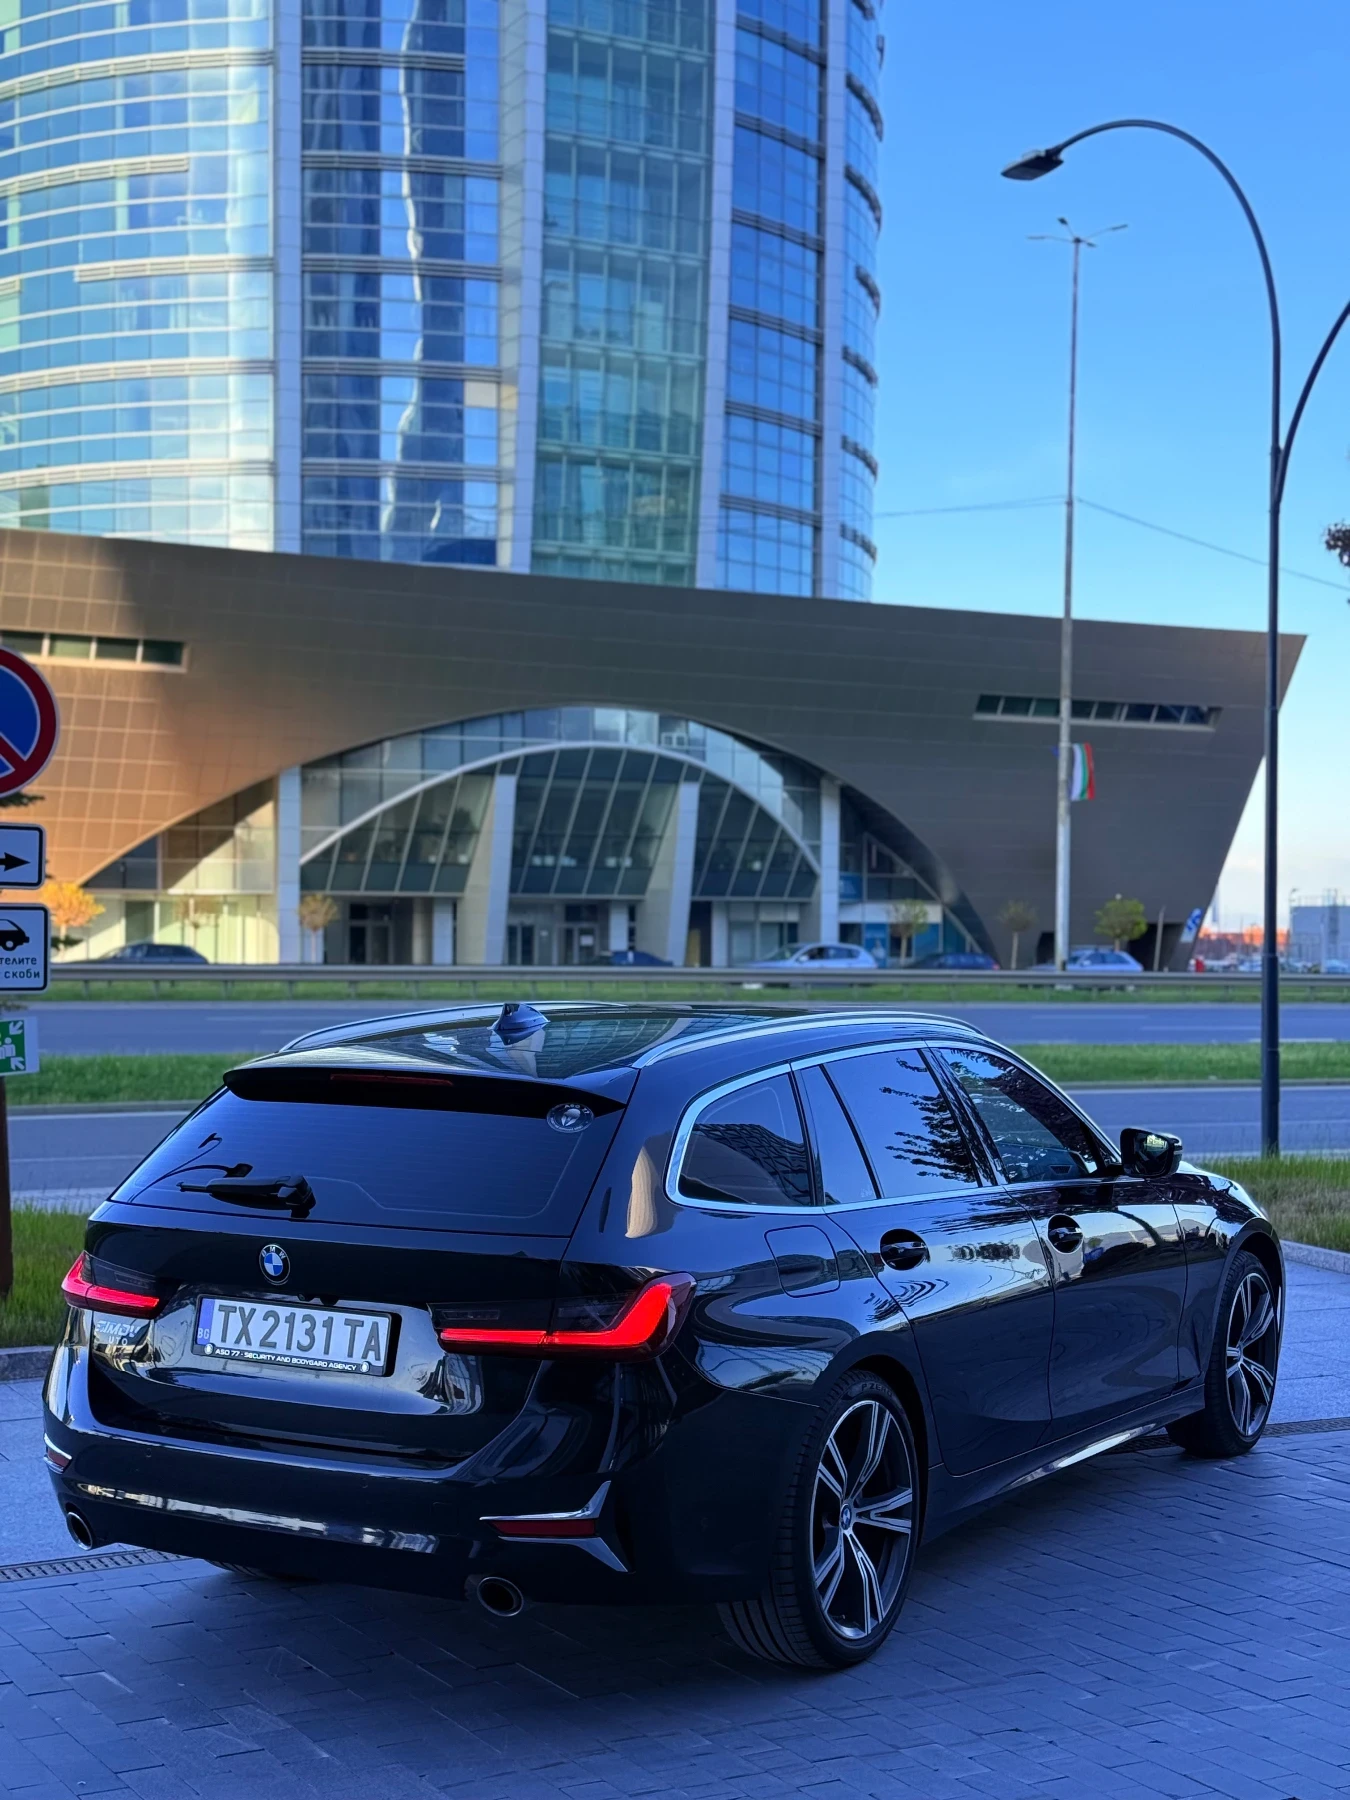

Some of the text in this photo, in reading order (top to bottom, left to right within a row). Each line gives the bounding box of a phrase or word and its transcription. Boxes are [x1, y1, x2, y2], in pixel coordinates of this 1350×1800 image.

[4, 969, 40, 978] скоби
[197, 1328, 210, 1340] BG
[218, 1305, 382, 1361] TX 2131 TA
[244, 1352, 275, 1361] SECURITY
[328, 1363, 357, 1371] AGENCY
